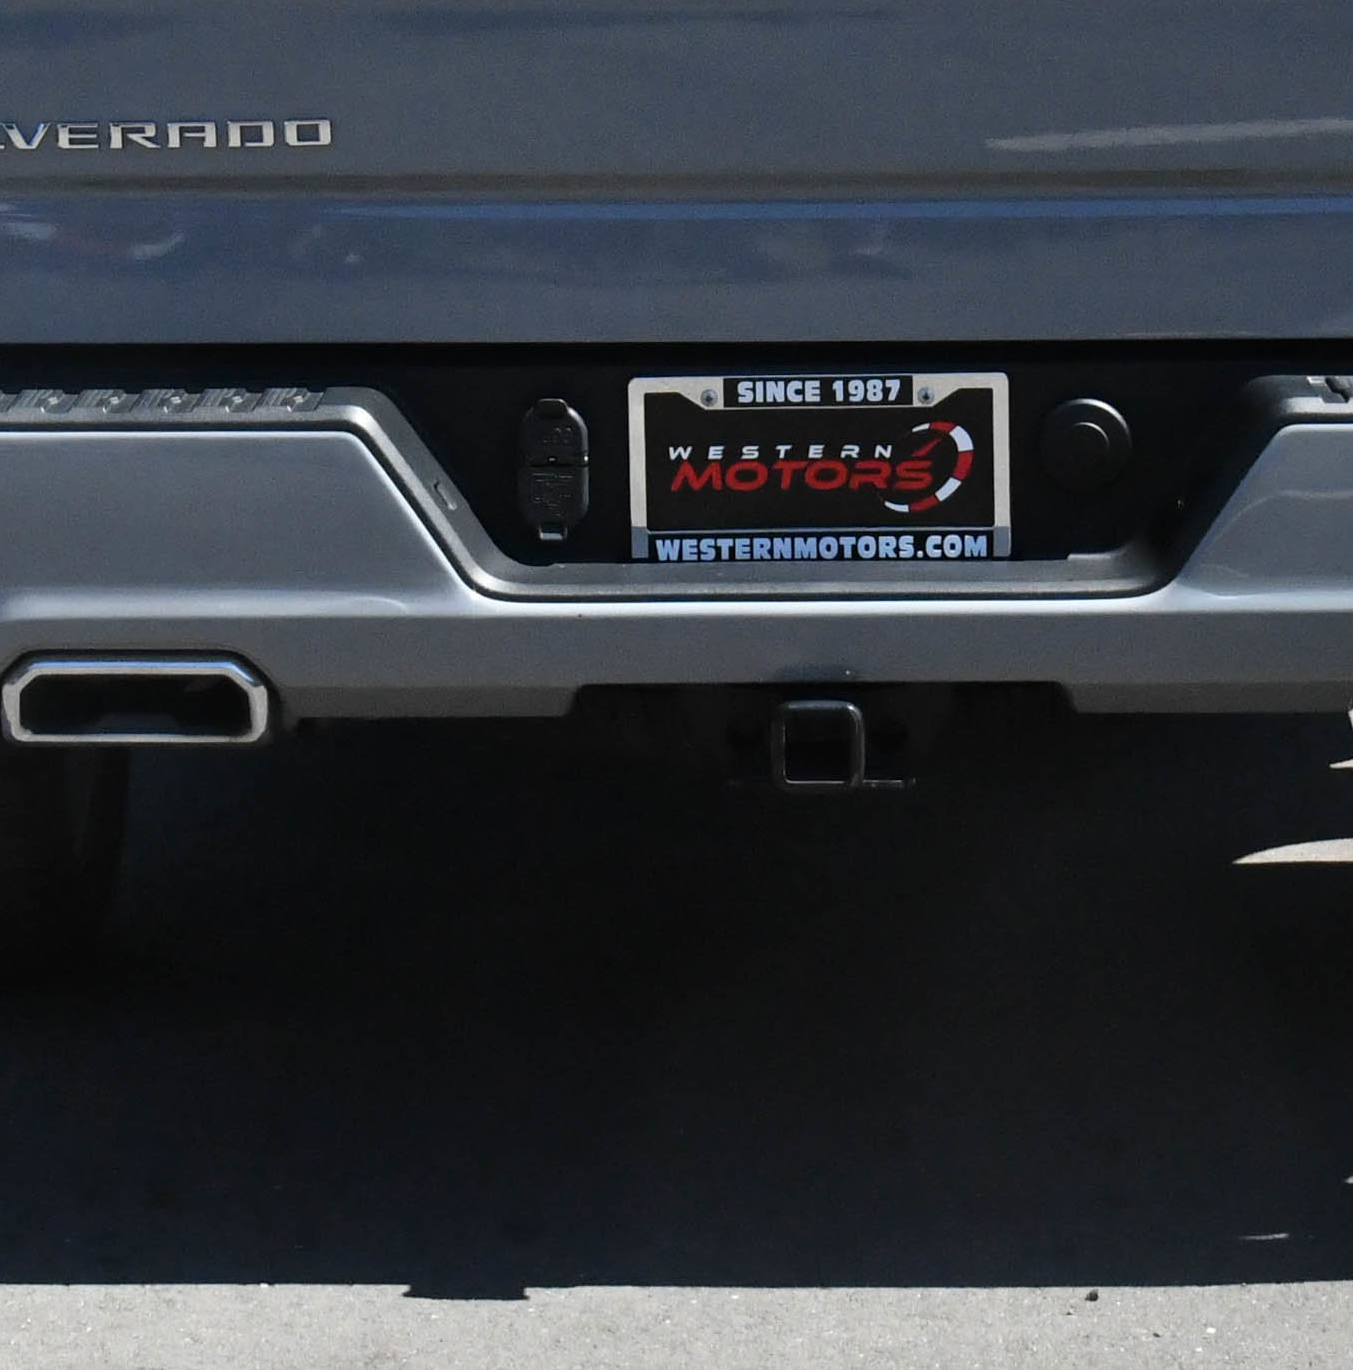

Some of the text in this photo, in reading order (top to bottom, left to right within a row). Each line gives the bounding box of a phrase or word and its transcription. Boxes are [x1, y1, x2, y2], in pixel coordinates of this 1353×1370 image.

[737, 378, 901, 404] SINCE 1987
[667, 443, 894, 461] WESTERN
[670, 459, 934, 492] MOTORS
[655, 534, 988, 562] WESTERNMOTORS.COM
